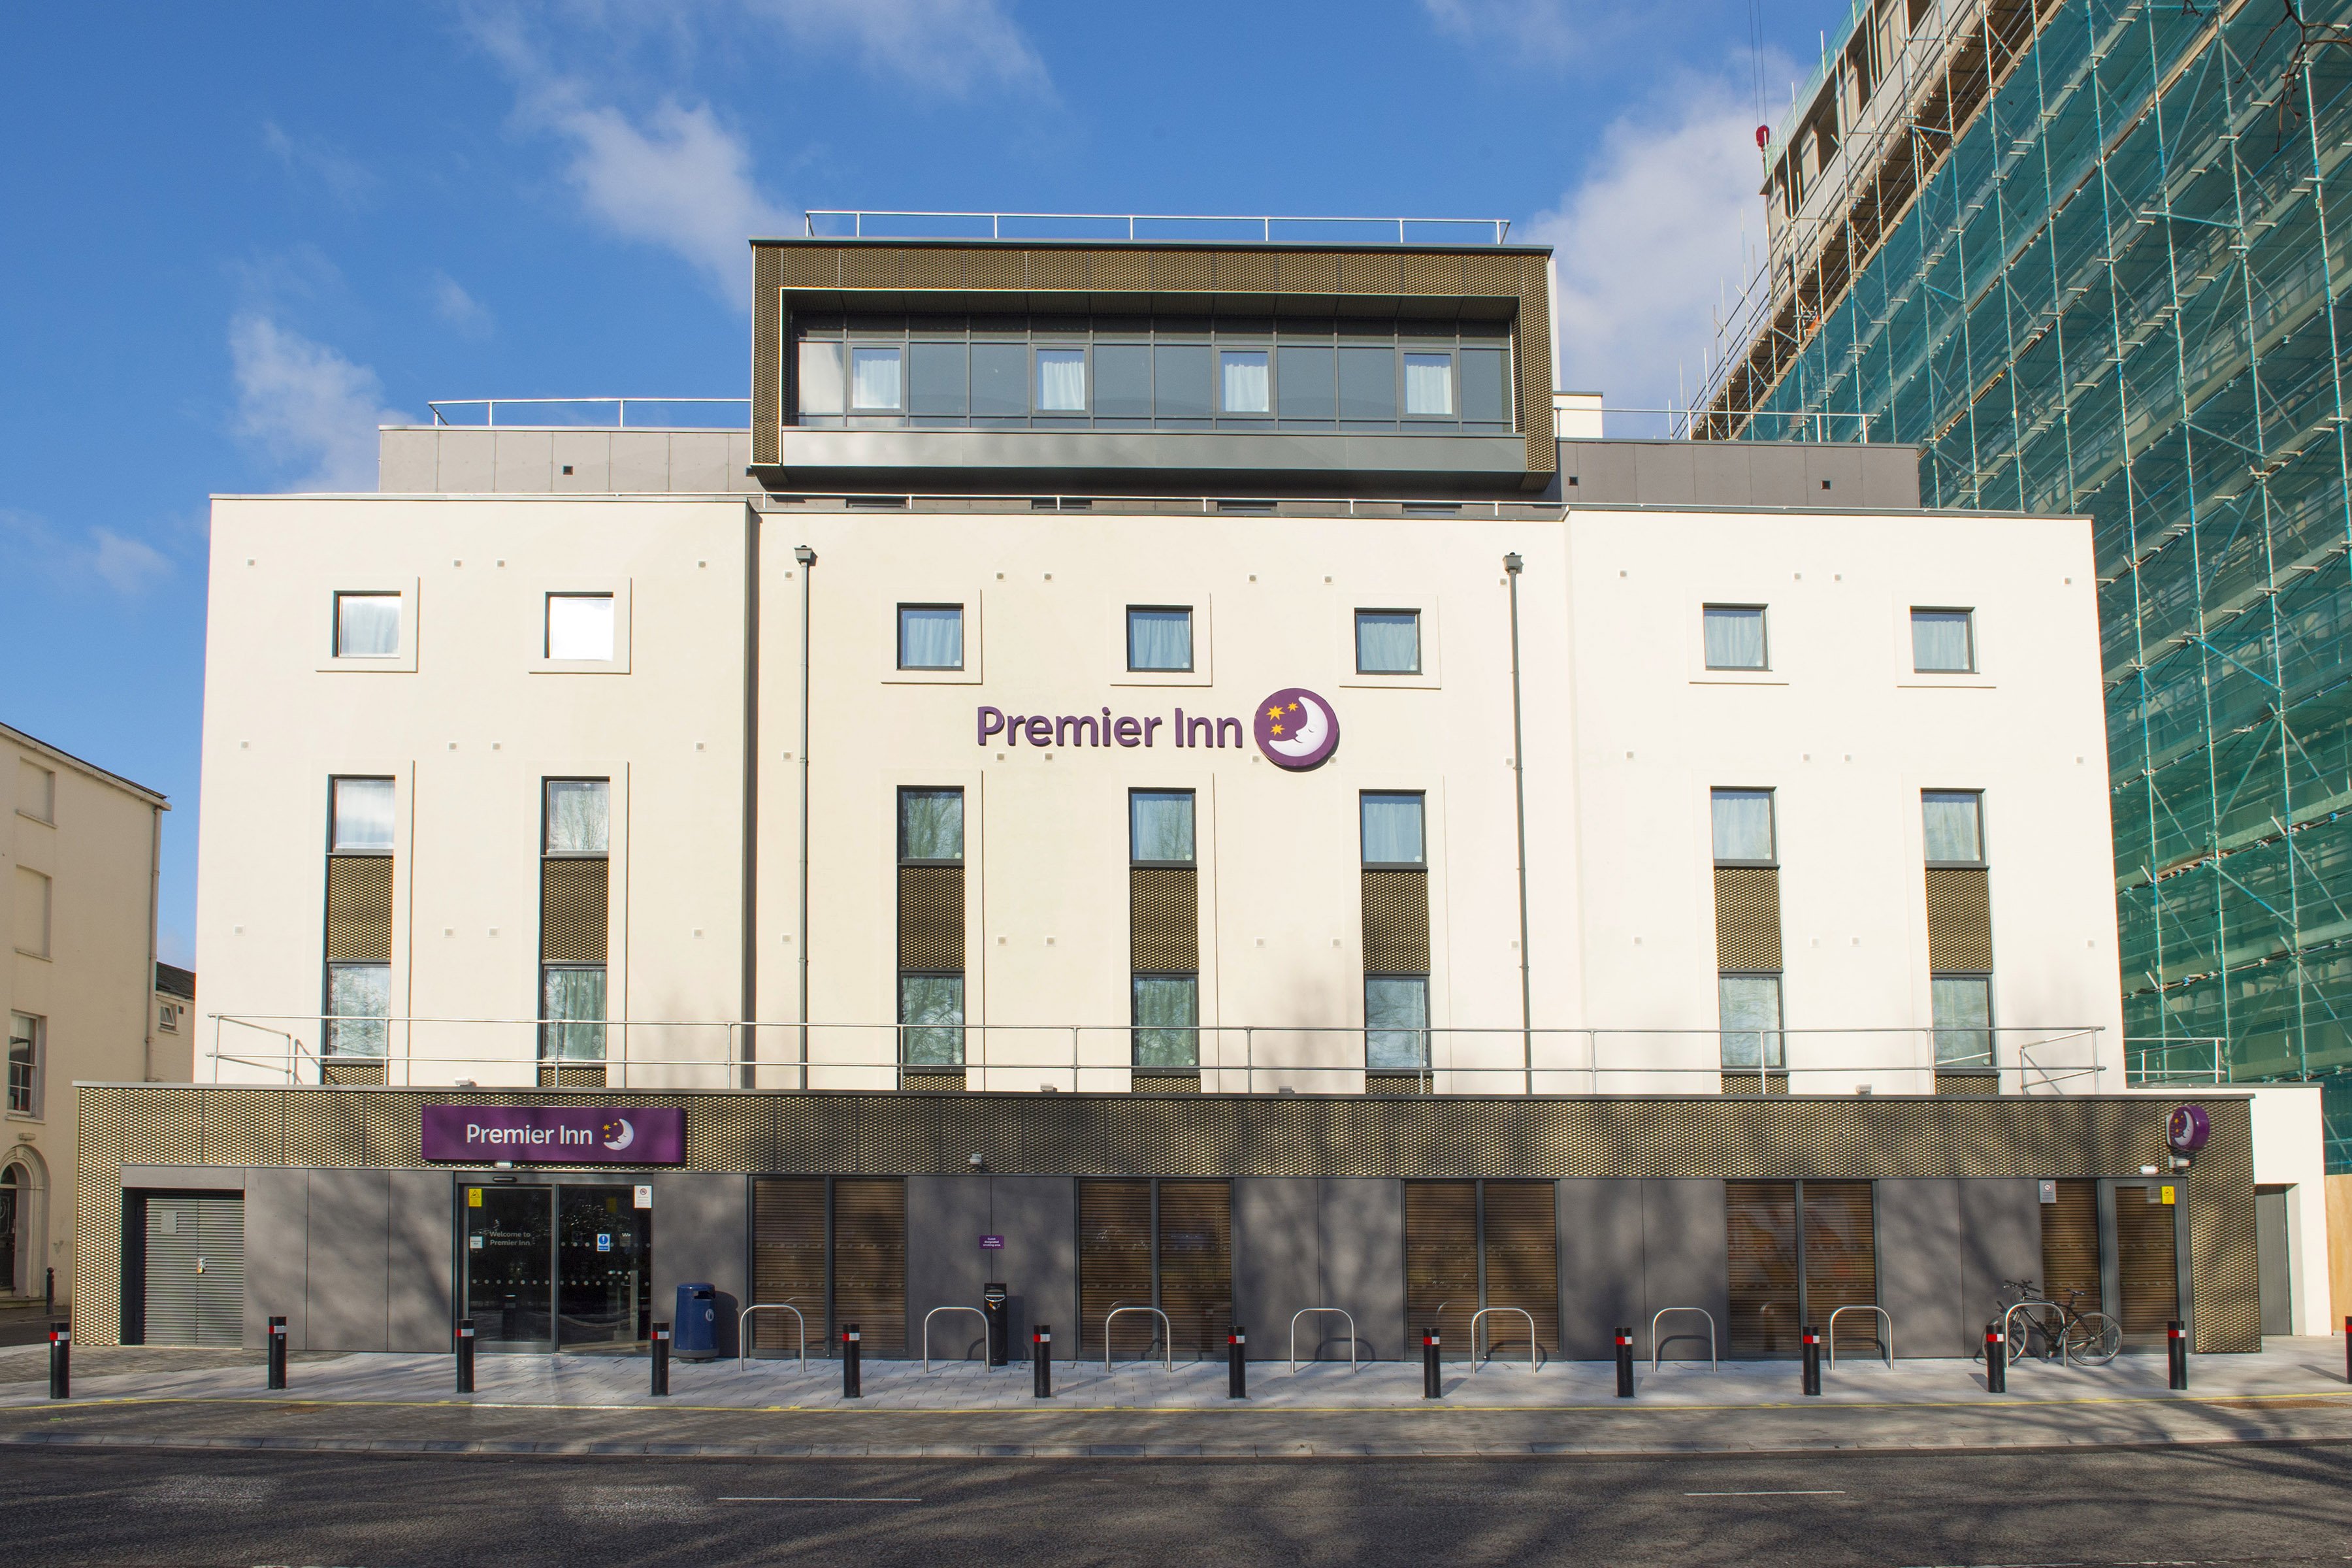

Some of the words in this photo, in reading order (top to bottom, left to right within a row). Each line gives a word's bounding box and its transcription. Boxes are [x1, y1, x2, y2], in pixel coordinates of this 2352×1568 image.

[977, 706, 1162, 748] Premier
[1174, 707, 1243, 749] Inn
[466, 1124, 555, 1144] Premier
[560, 1124, 593, 1145] Inn
